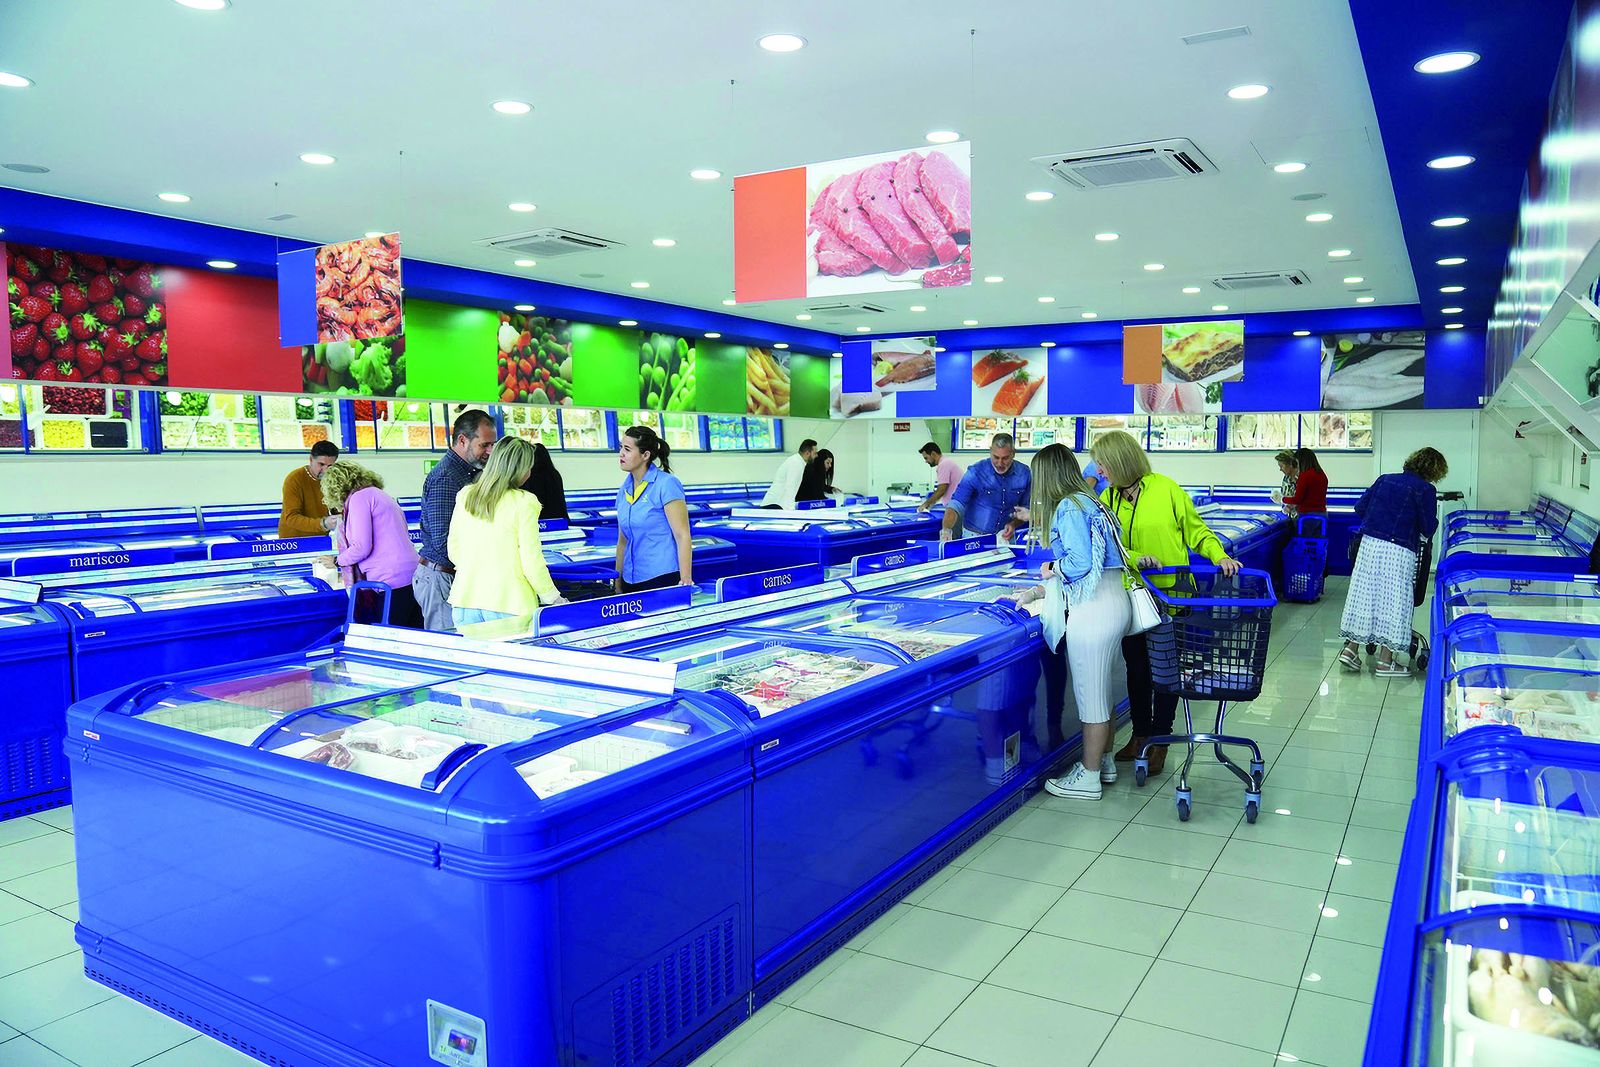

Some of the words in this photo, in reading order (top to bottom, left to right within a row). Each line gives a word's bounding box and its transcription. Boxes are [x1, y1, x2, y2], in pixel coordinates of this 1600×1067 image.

[252, 540, 298, 553] mariscos
[69, 552, 130, 567] mariscos
[763, 573, 792, 589] carnes
[601, 599, 643, 618] carnes
